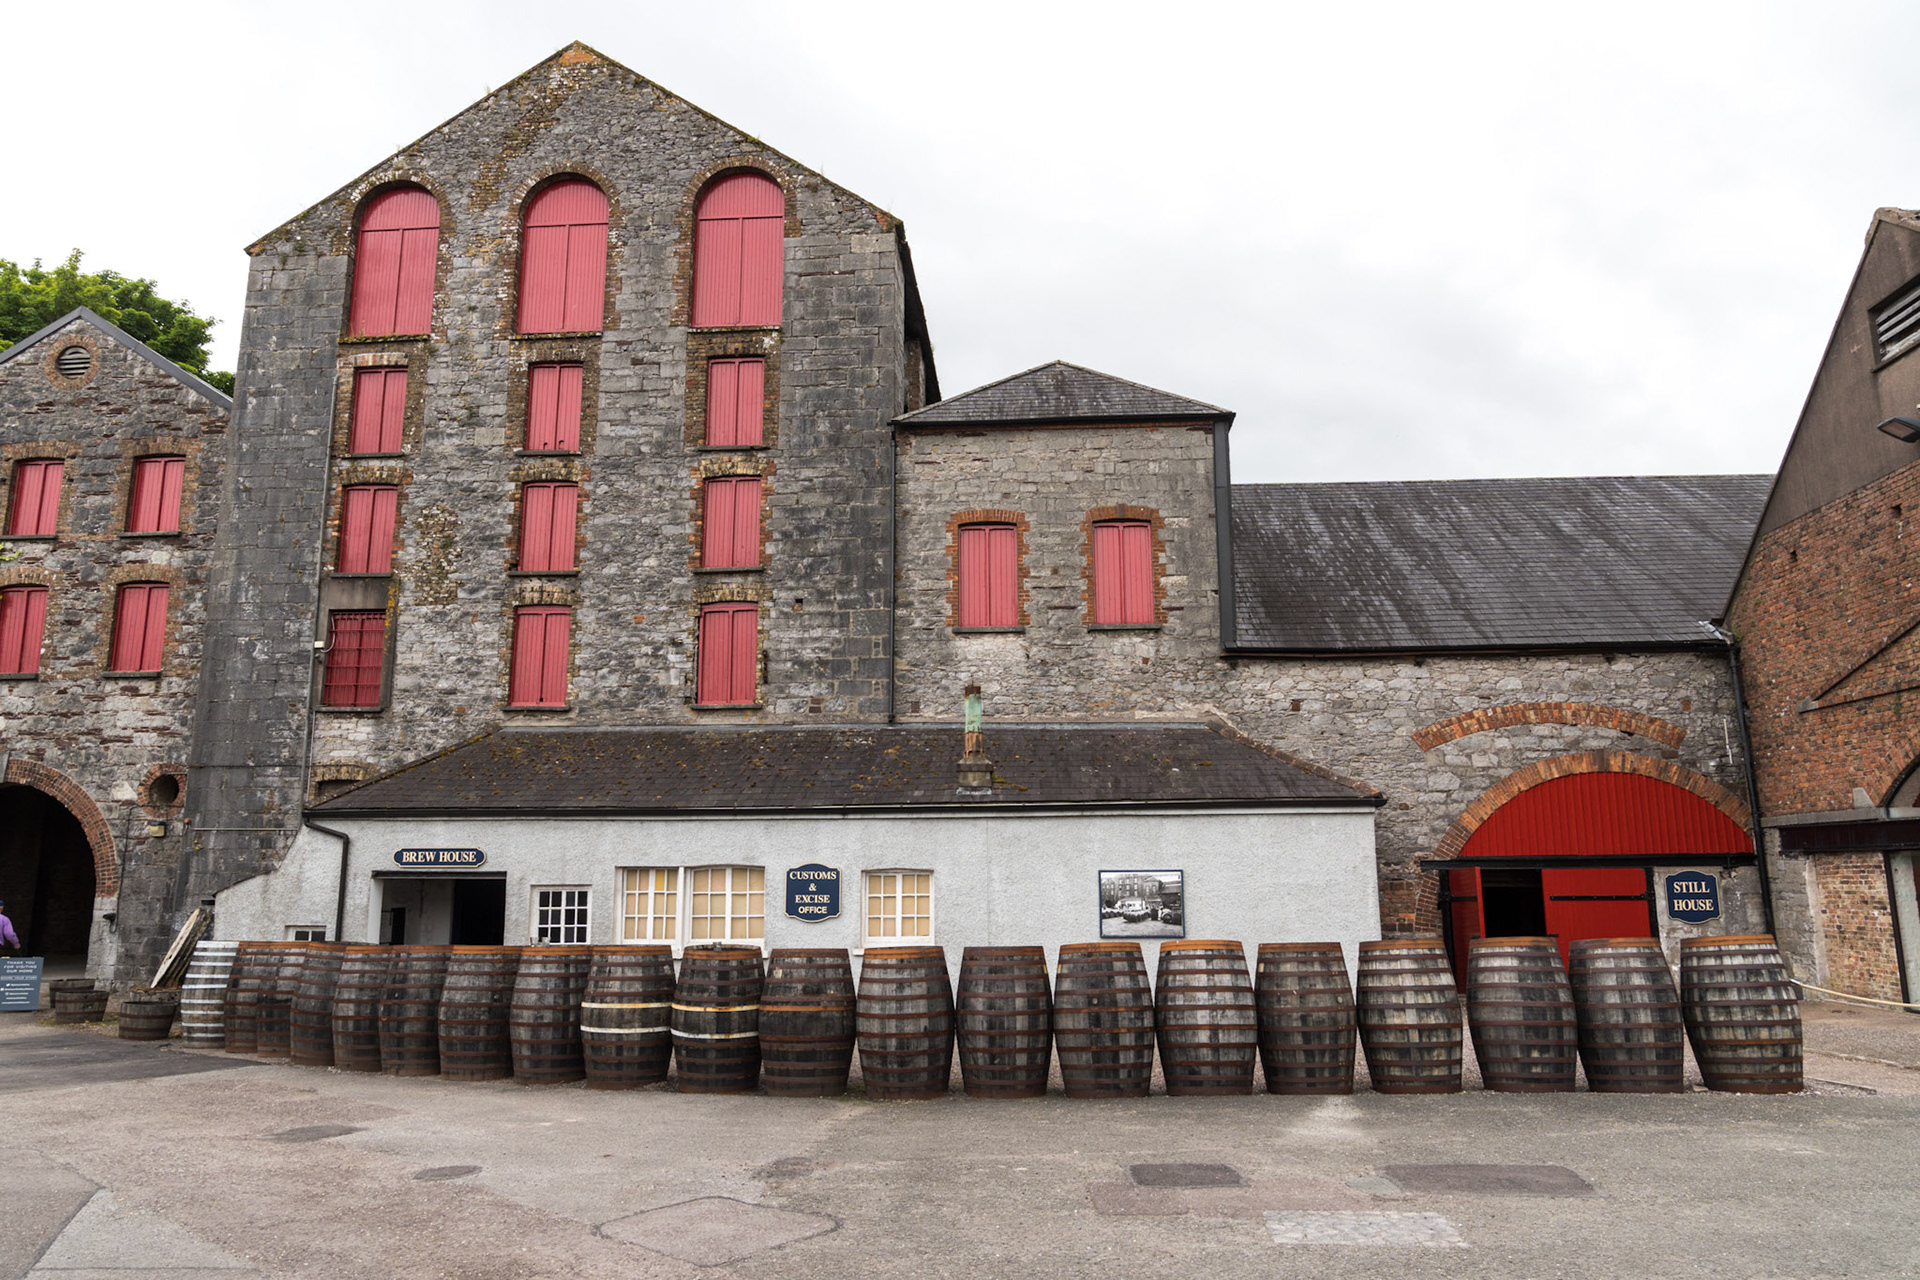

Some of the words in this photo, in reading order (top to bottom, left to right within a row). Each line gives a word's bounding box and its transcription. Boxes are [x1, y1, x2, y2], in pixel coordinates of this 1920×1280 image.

[402, 851, 436, 863] BREW
[439, 851, 477, 863] HOUSE
[789, 871, 837, 880] CUSTOMS
[808, 883, 817, 891] &
[1673, 881, 1710, 893] STILL
[795, 894, 830, 904] EXCISE
[798, 906, 828, 914] OFFICE
[1673, 899, 1714, 911] HOUSE
